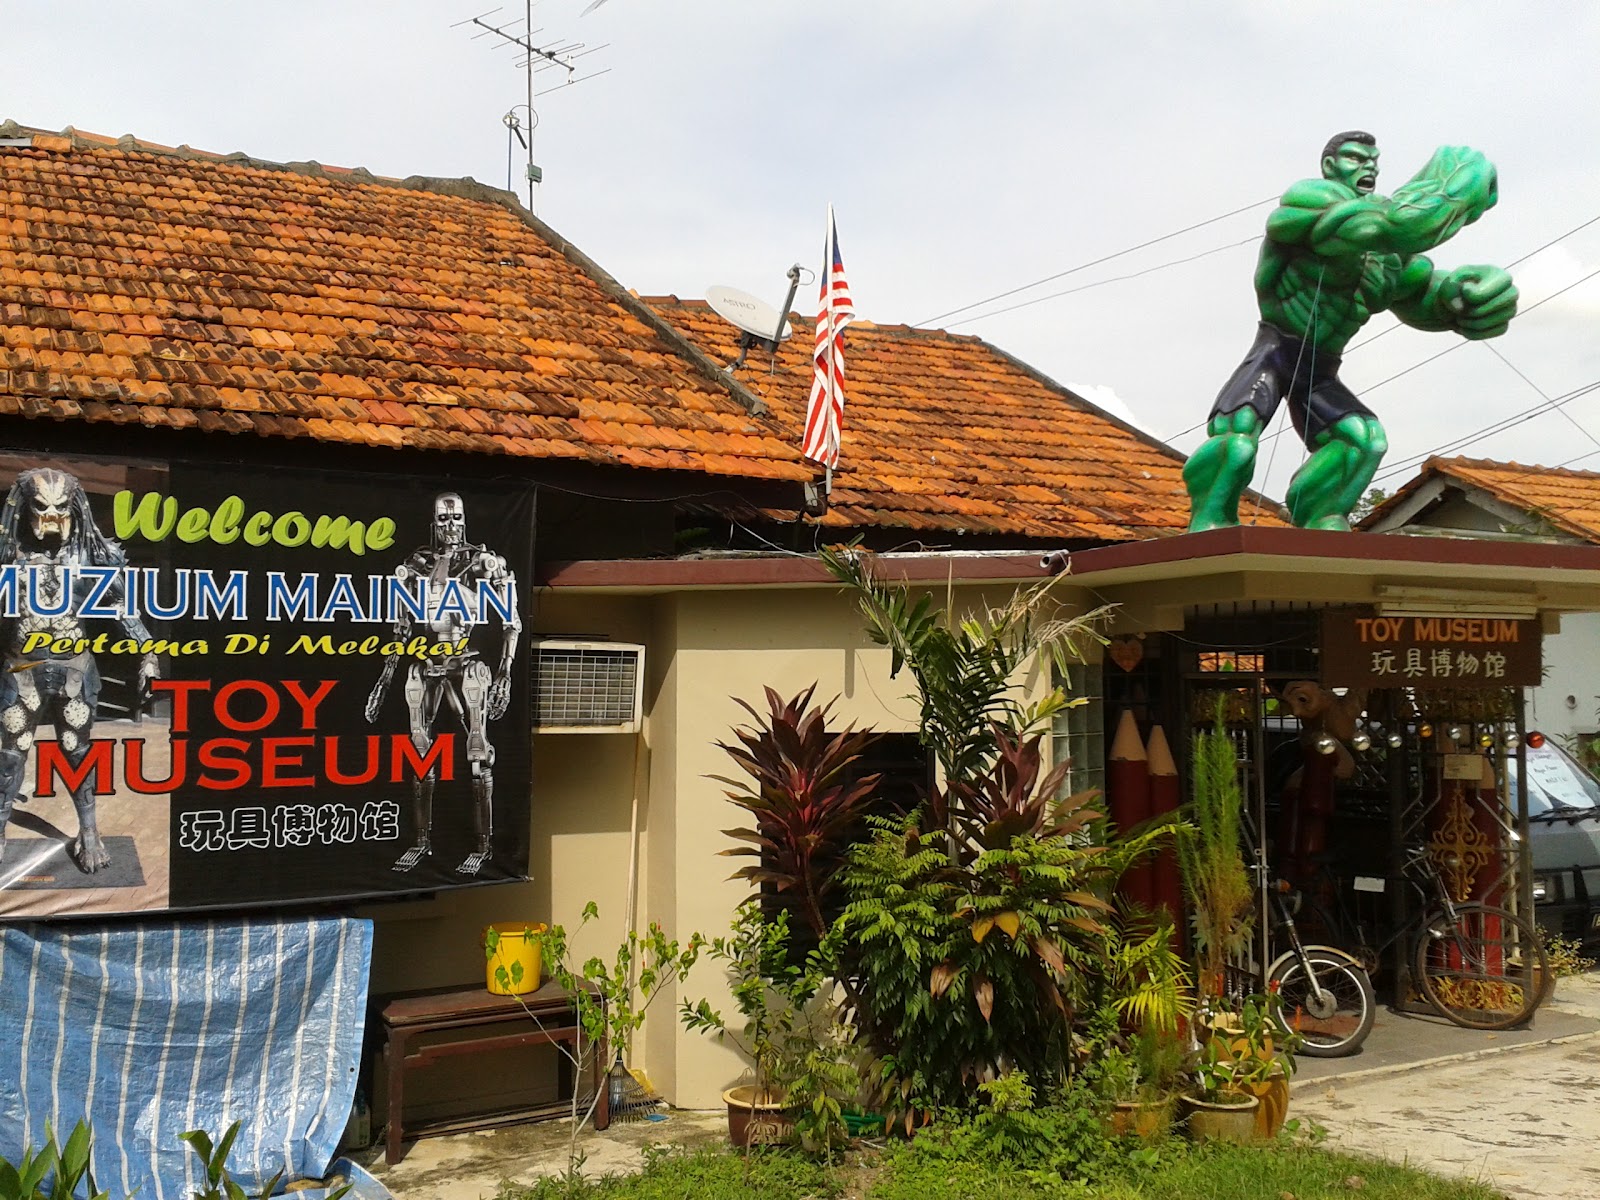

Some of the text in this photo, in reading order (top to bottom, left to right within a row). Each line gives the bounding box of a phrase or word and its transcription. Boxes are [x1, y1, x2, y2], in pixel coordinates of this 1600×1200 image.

[113, 489, 396, 557] Welcome
[266, 571, 517, 625] MAINAN
[22, 631, 470, 660] Pertama Di Melaka!
[1355, 617, 1519, 643] TOY MUSEUM
[1371, 648, 1506, 678] 玩具博物馆
[151, 679, 340, 734] TOY
[34, 733, 456, 798] MUSEUM
[179, 800, 400, 852] 玩具博物馆
